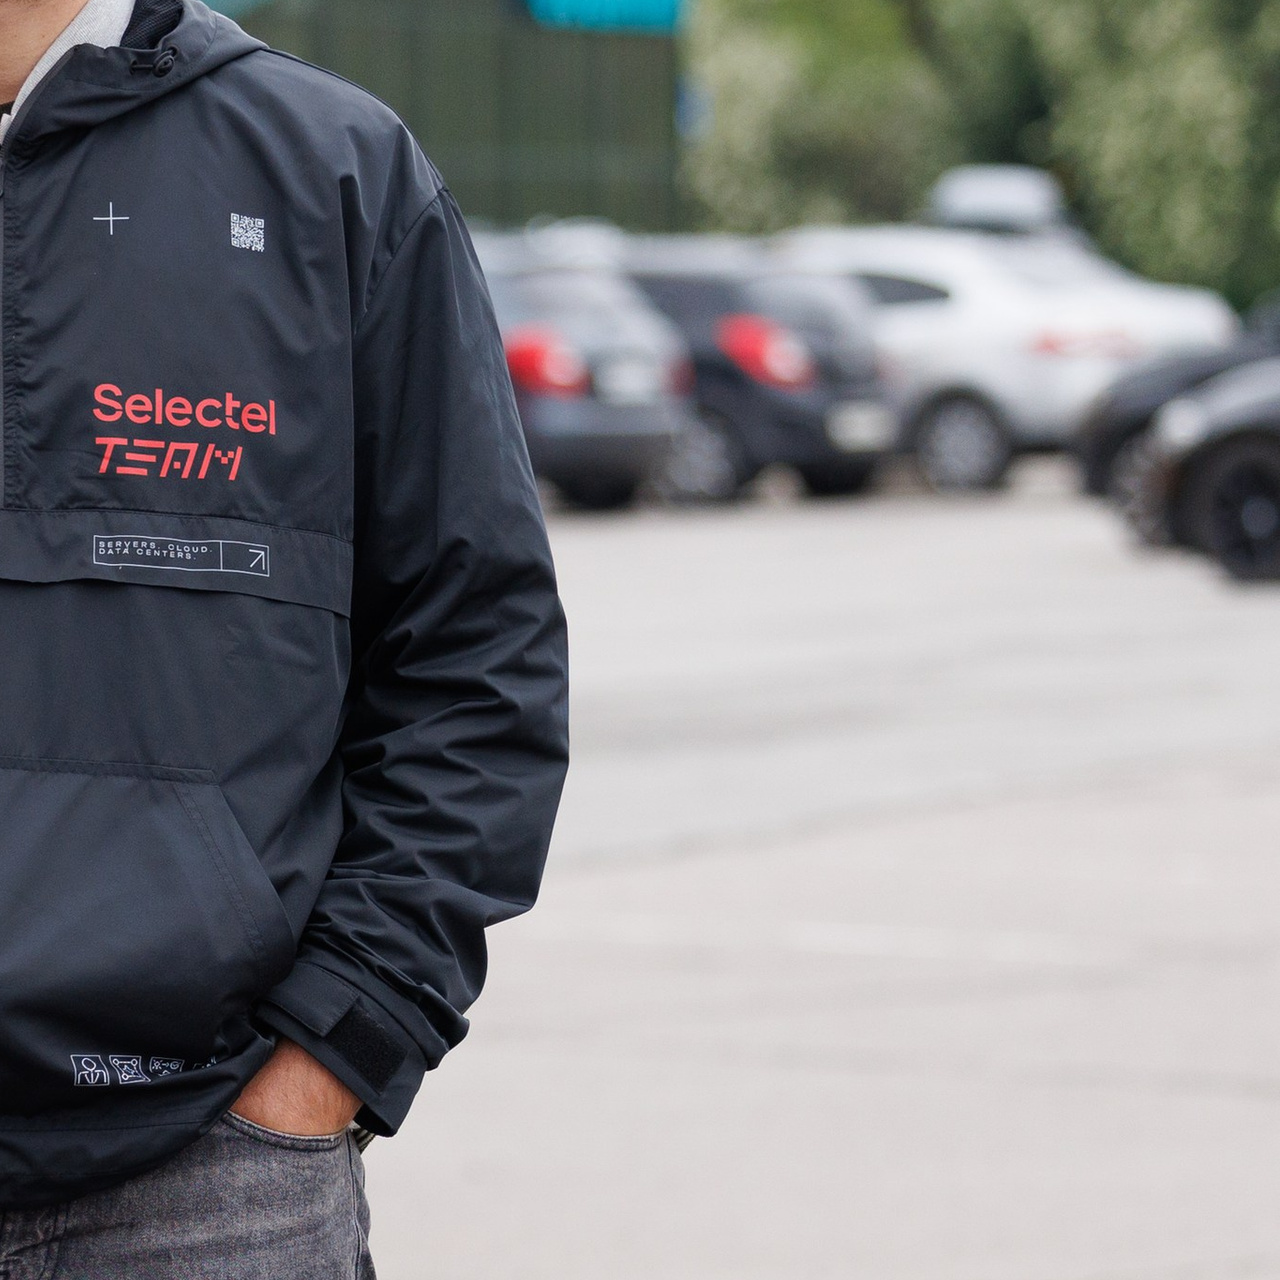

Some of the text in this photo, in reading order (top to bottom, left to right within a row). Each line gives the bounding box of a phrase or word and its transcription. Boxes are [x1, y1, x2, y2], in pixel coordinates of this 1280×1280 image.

[92, 383, 276, 436] Selectel
[95, 437, 243, 481] TEAM
[98, 541, 213, 553] SERVERS. CLOUD.
[136, 548, 197, 560] CENTERS.
